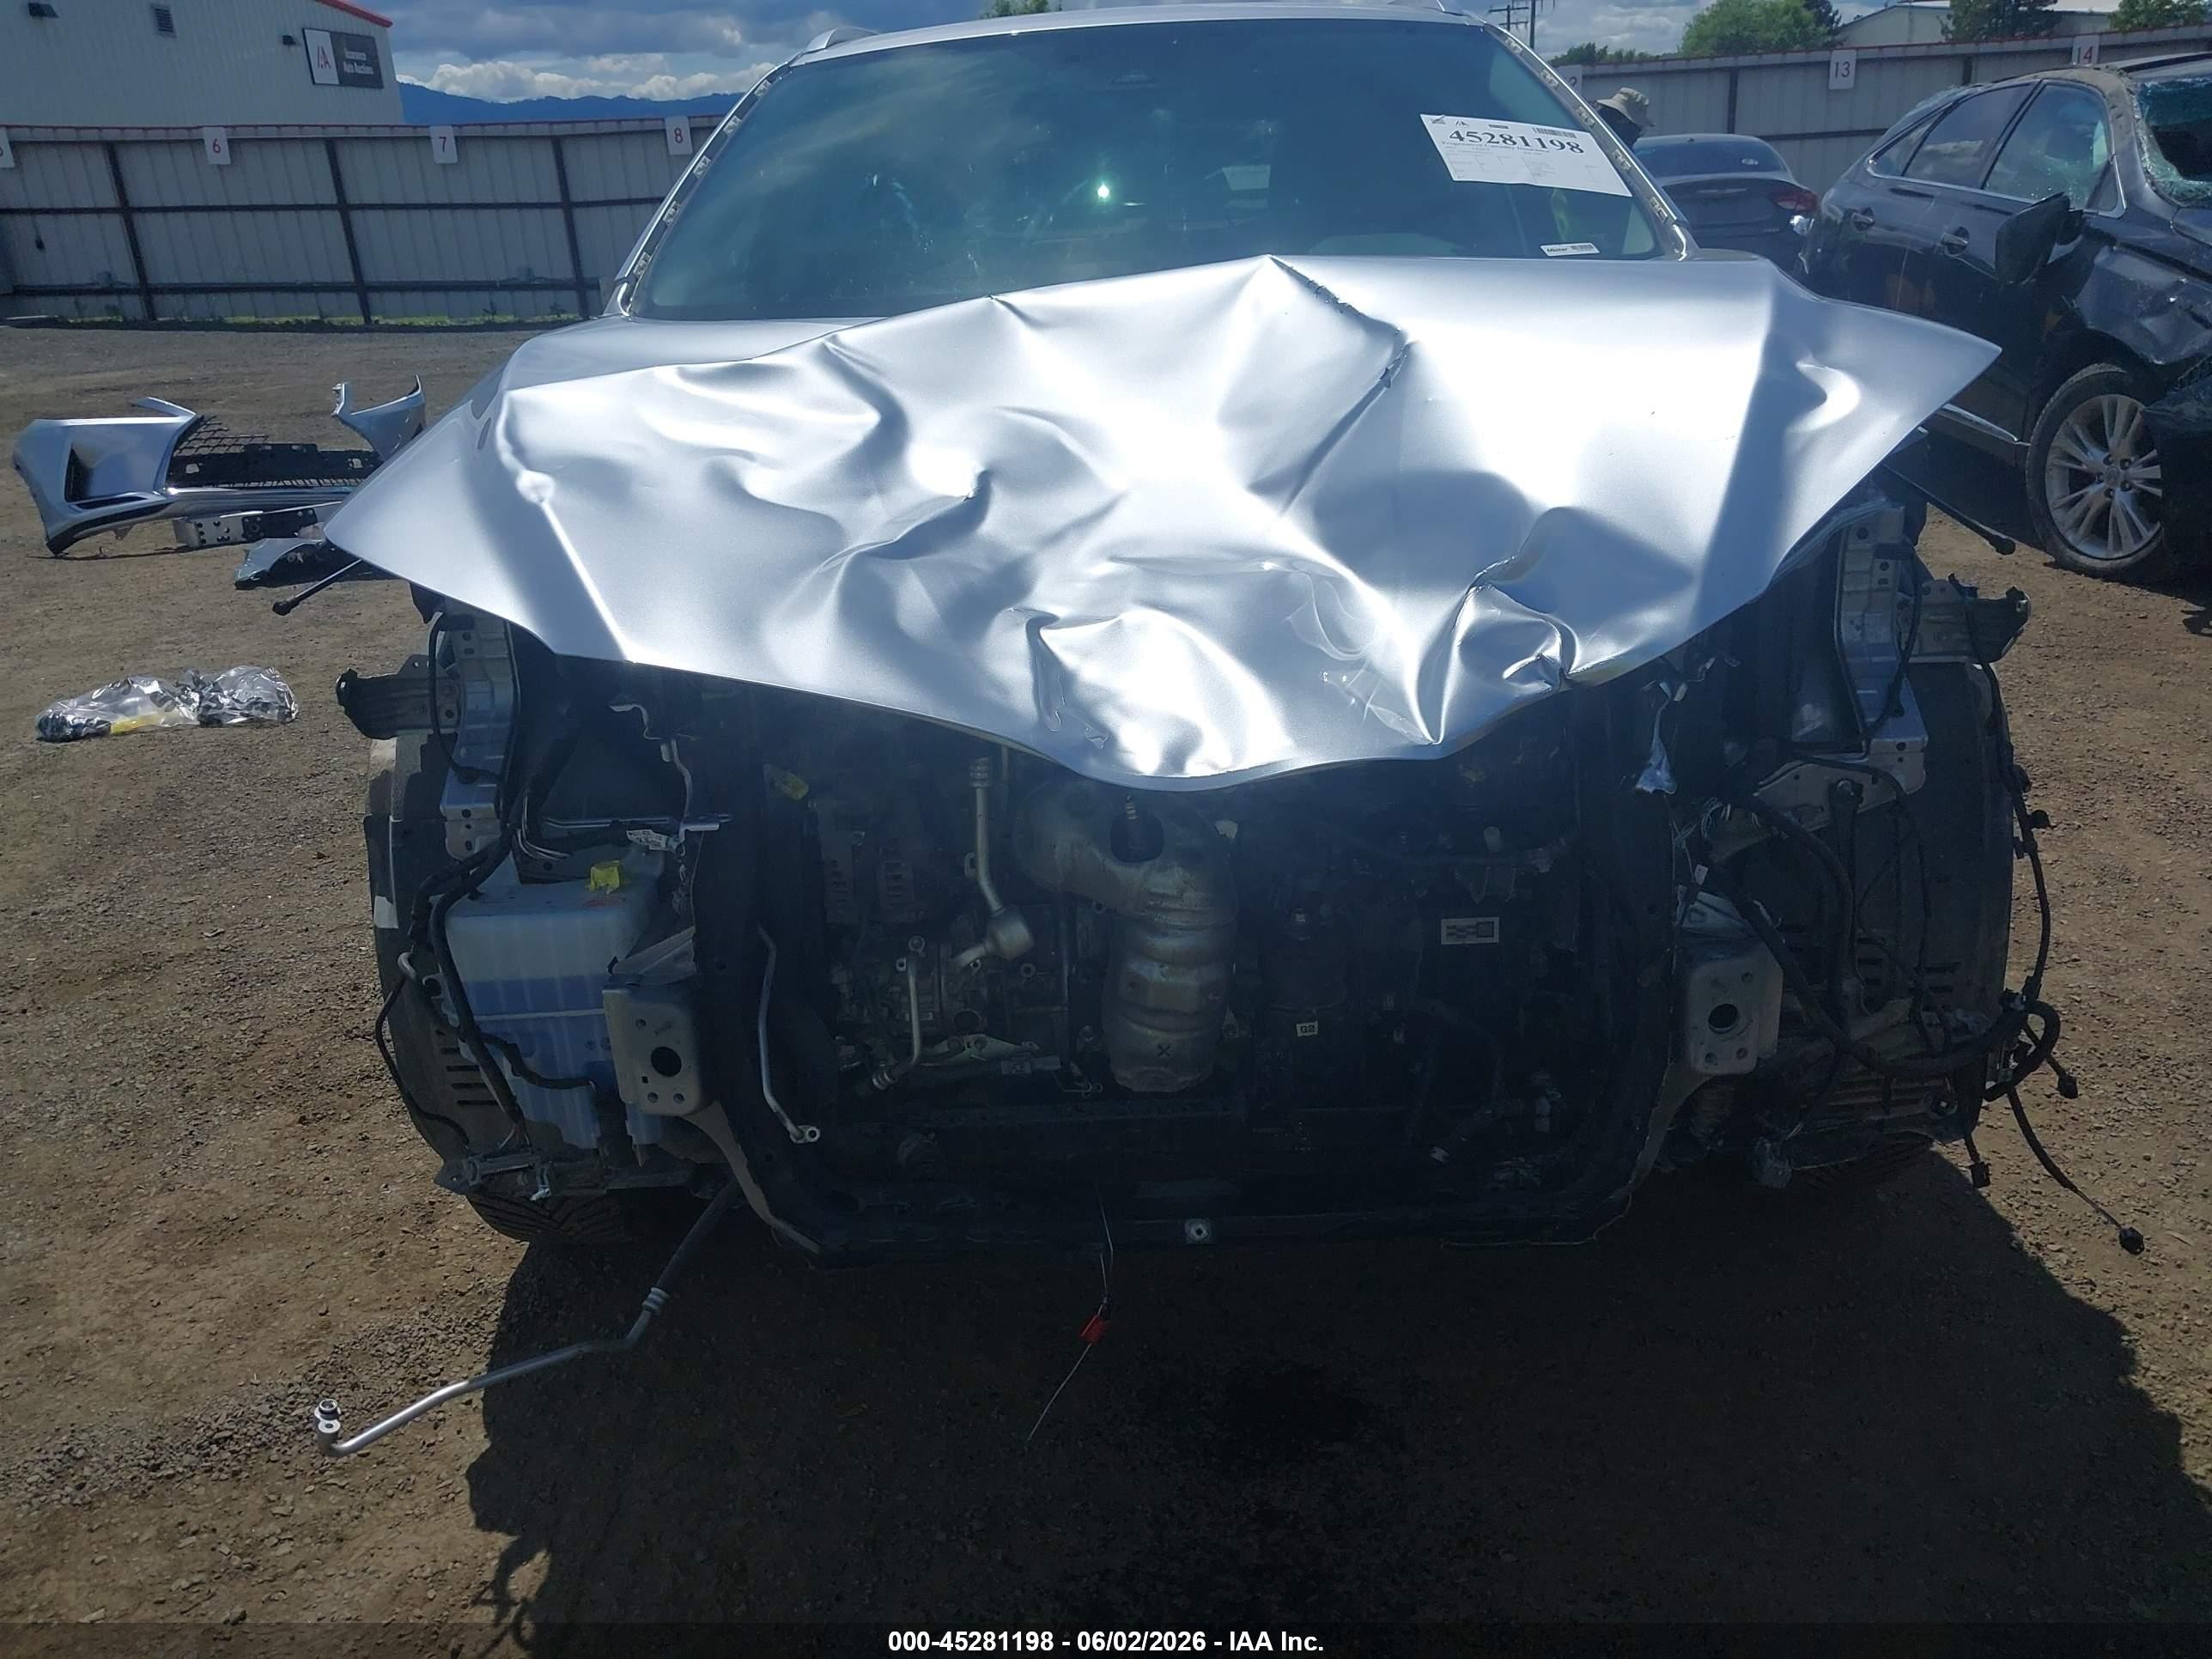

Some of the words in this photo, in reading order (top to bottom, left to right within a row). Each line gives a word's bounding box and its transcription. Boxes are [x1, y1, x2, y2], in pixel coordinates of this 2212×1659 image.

[2078, 46, 2094, 64] 14
[1834, 61, 1850, 79] 13
[674, 127, 684, 144] 8
[1449, 130, 1585, 154] 45281198
[212, 138, 221, 154] 6
[439, 137, 447, 152] 7
